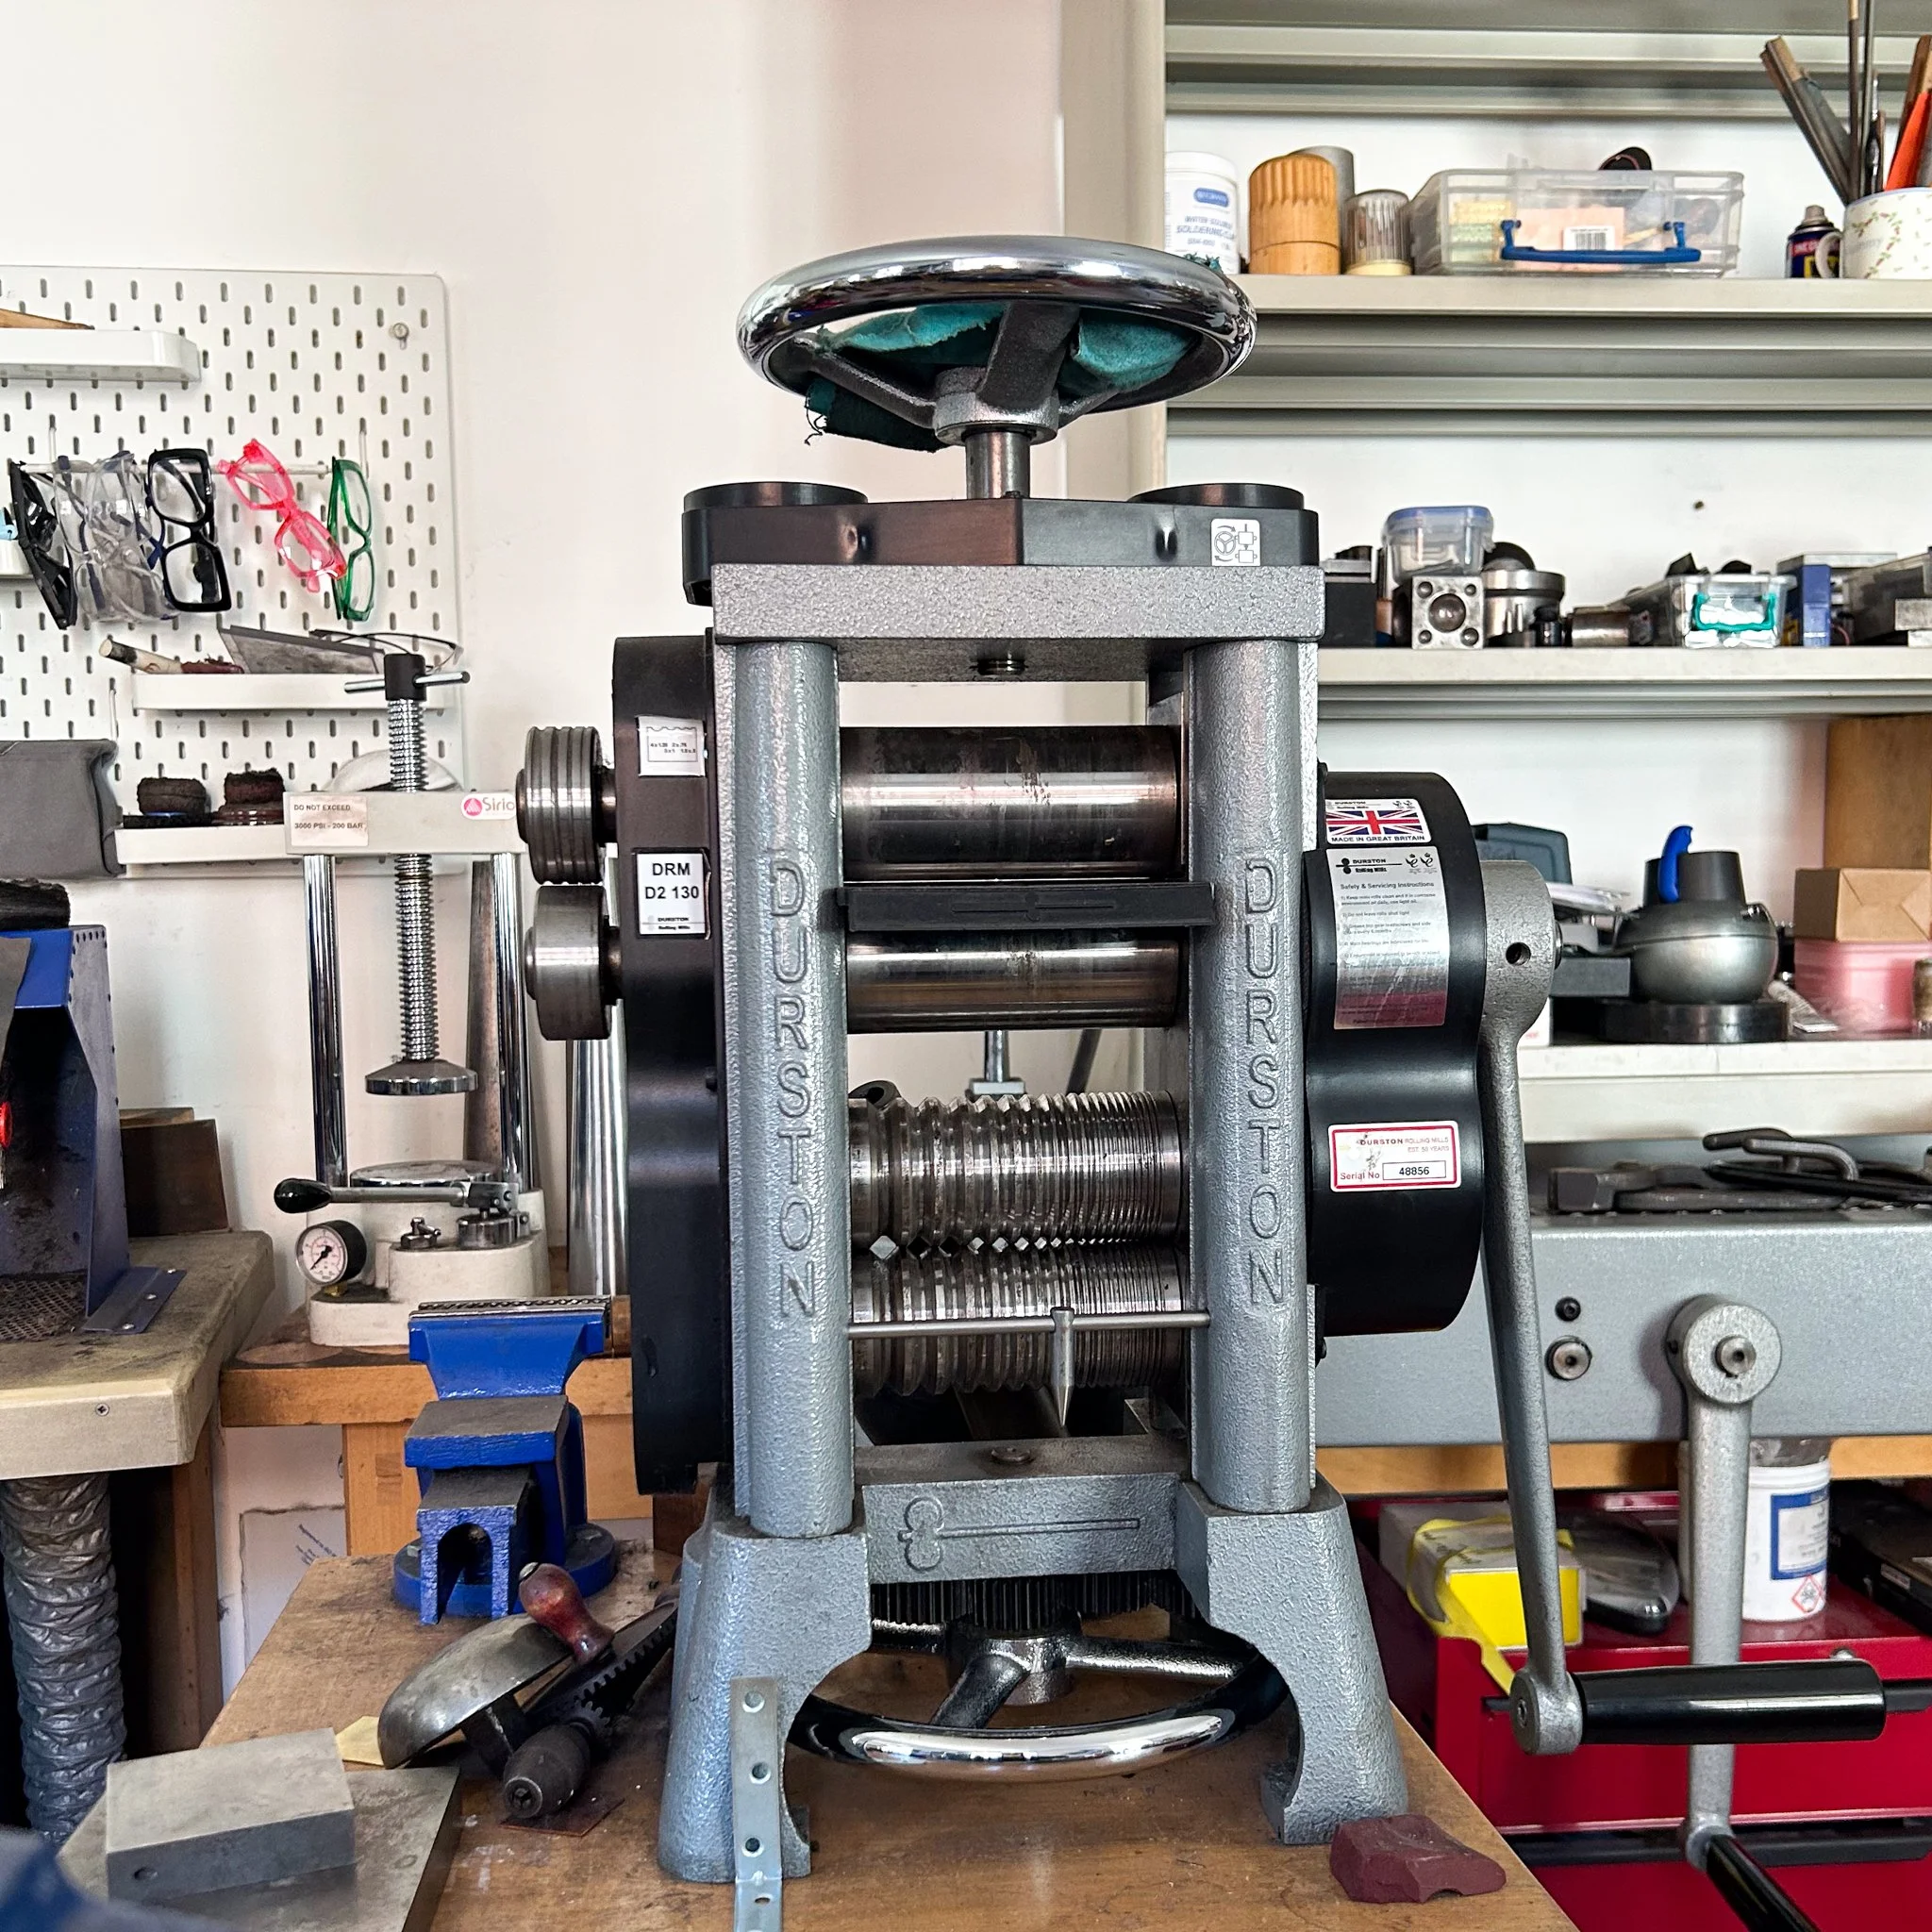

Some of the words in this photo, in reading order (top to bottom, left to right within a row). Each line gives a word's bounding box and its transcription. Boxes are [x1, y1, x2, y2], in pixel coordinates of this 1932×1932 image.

[482, 797, 515, 811] Sirio
[652, 862, 691, 875] DRM
[645, 886, 666, 899] D2
[672, 886, 700, 899] 130
[1245, 858, 1284, 1305] DURSTON
[770, 859, 816, 1318] DURSTON
[1399, 1166, 1429, 1175] 48856
